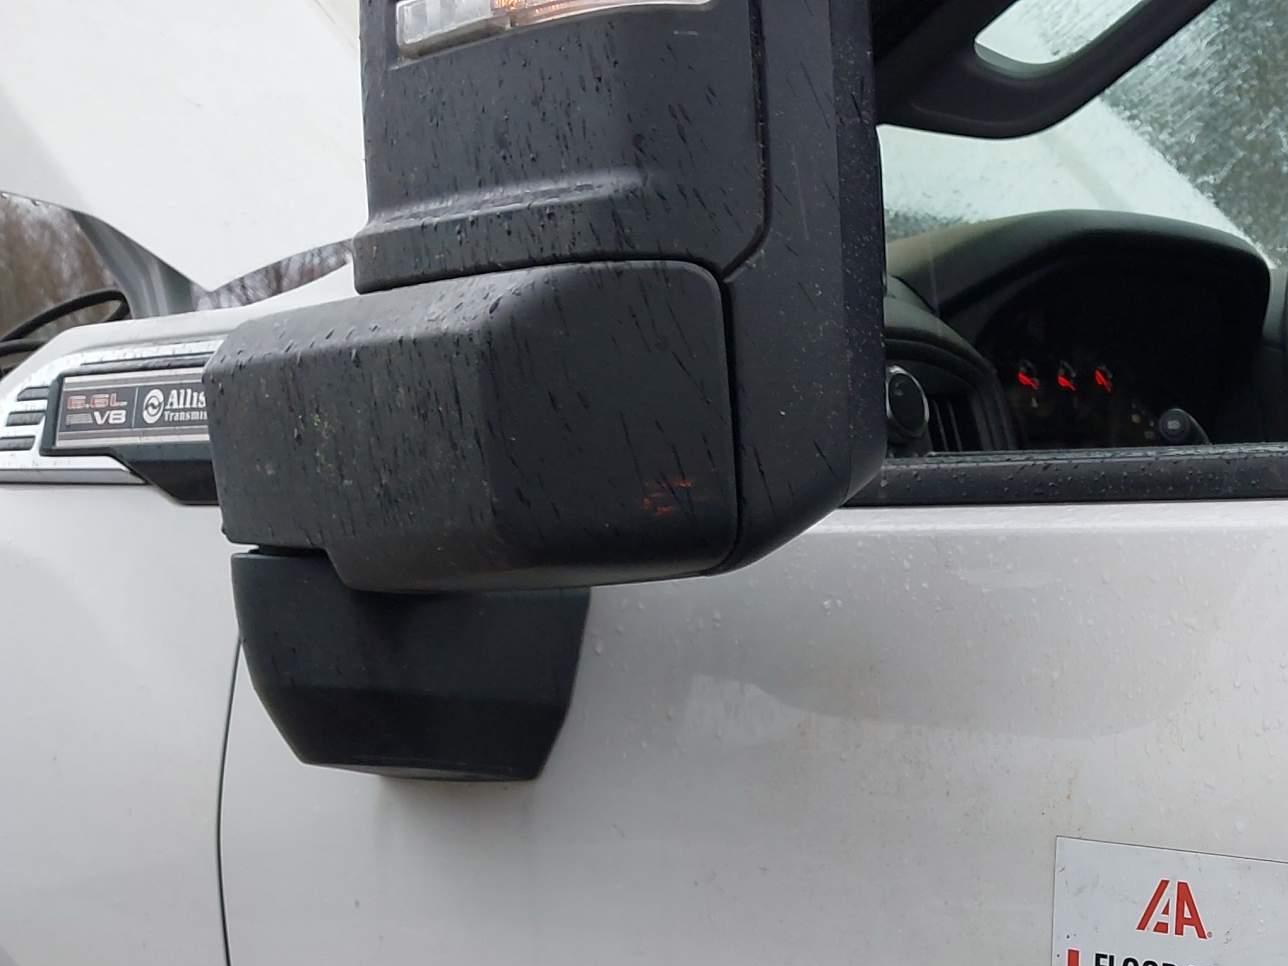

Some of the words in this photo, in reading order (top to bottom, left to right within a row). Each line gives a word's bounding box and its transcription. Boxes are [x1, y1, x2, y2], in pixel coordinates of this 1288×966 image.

[67, 393, 128, 410] 6.6L
[93, 409, 126, 425] V8
[1136, 879, 1208, 940] IAA
